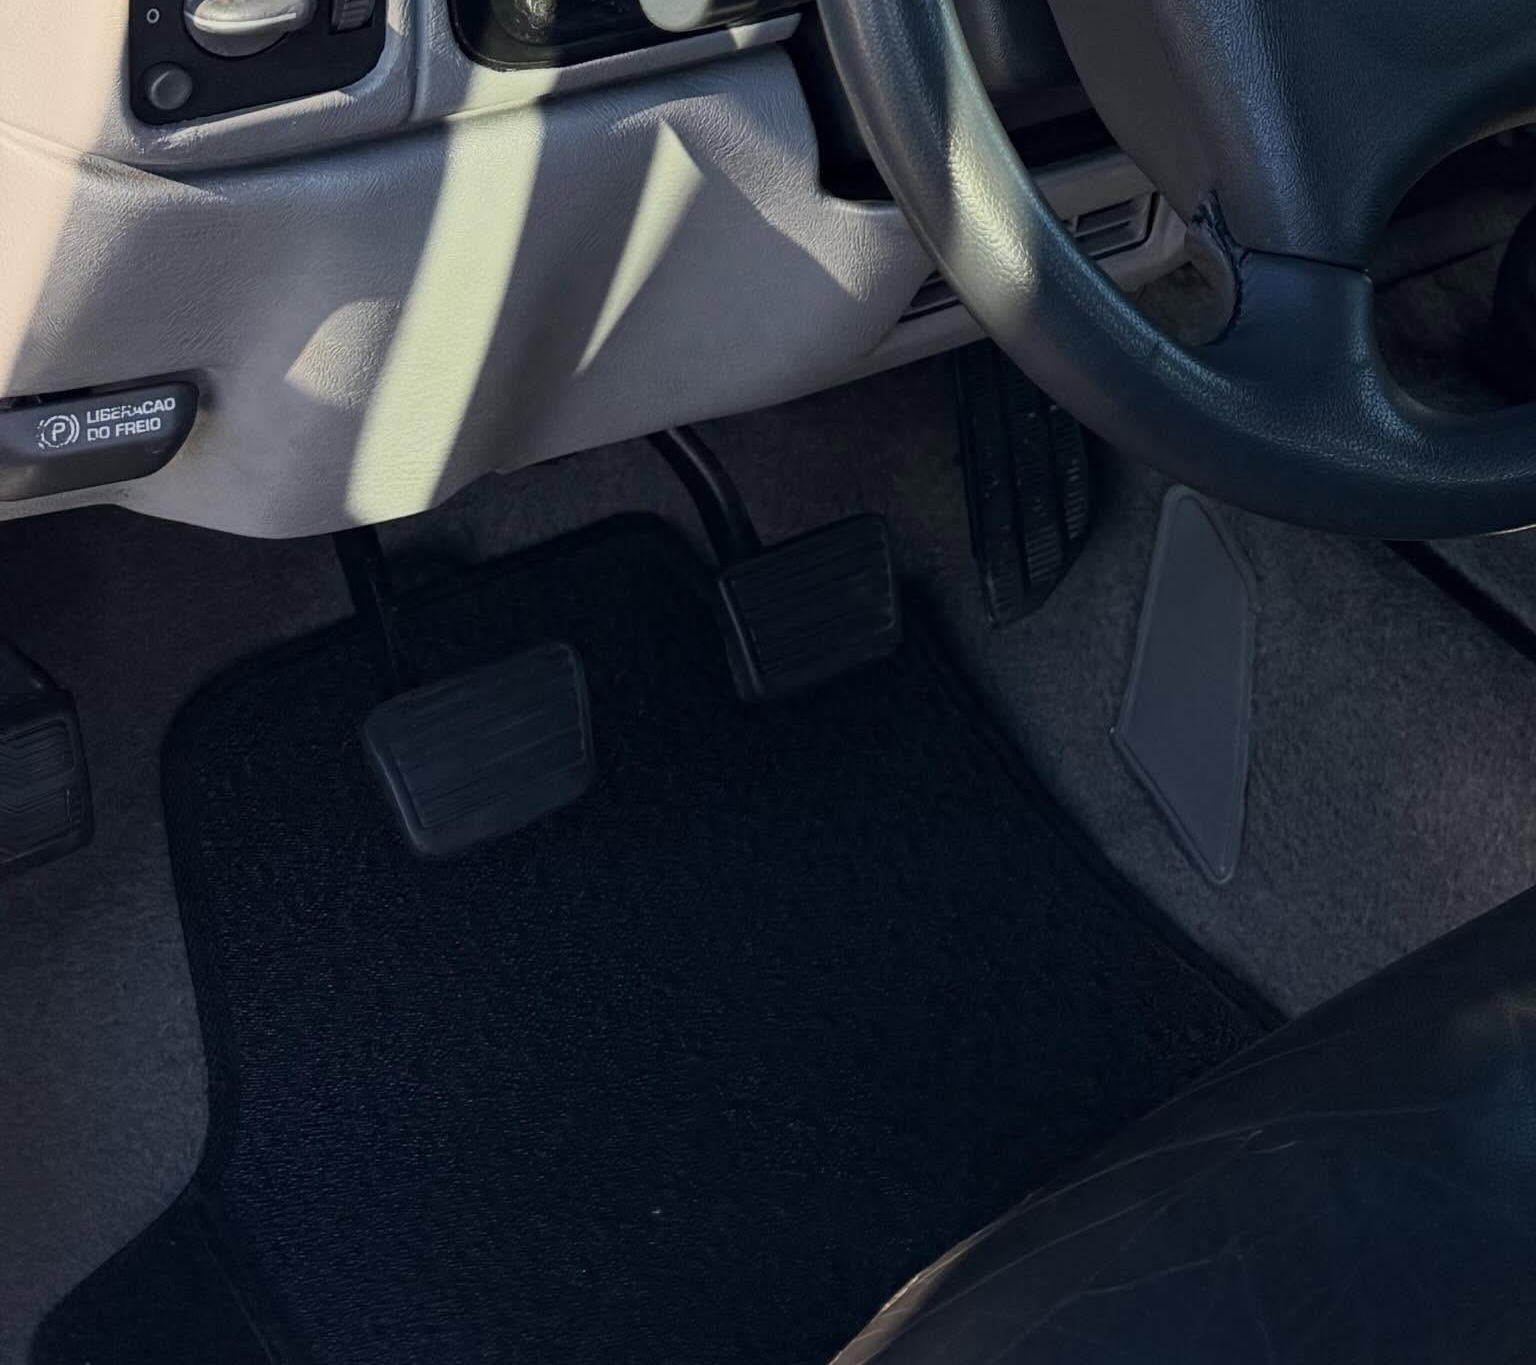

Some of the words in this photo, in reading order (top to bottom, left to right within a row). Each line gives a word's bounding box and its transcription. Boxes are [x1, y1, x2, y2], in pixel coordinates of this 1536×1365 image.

[87, 397, 176, 424] LIBERACAO
[87, 426, 110, 442] DO
[115, 417, 162, 437] FREIO
